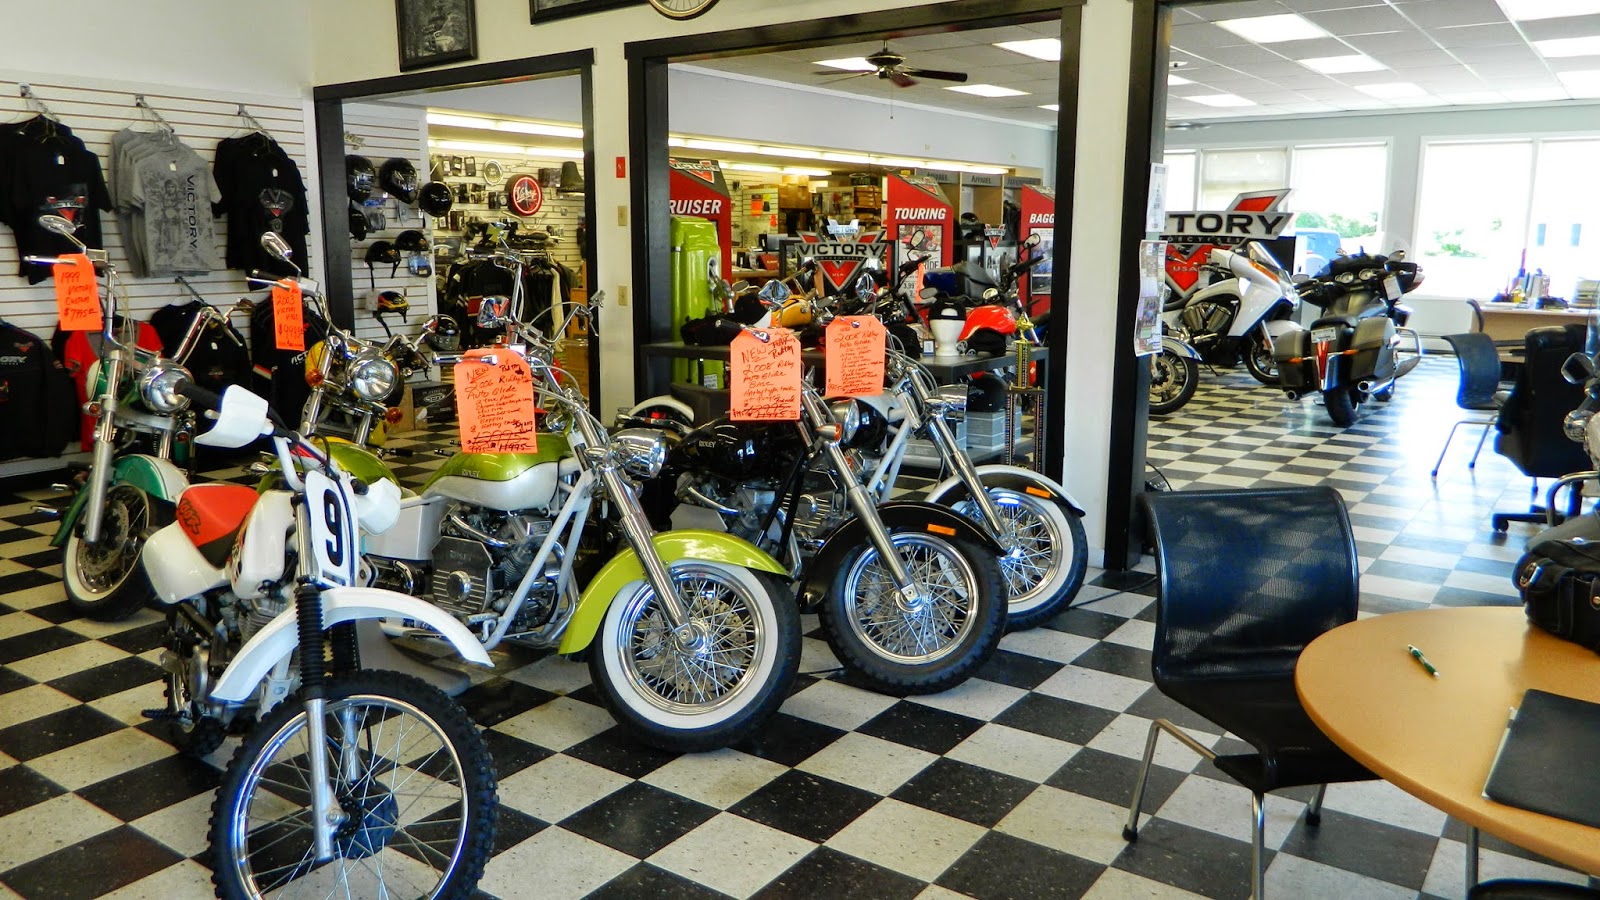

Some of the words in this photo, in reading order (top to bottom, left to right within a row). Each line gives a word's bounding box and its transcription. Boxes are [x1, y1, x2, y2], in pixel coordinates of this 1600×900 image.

[186, 174, 198, 249] VICTORY
[670, 199, 722, 214] RUISER
[895, 207, 946, 220] TOURING
[1029, 213, 1054, 224] BAGG
[1168, 213, 1285, 235] TORY
[799, 243, 881, 256] VICTORY
[61, 271, 80, 284] 1999
[741, 345, 767, 363] NEW
[466, 365, 490, 381] NEW
[323, 488, 344, 567] 9
